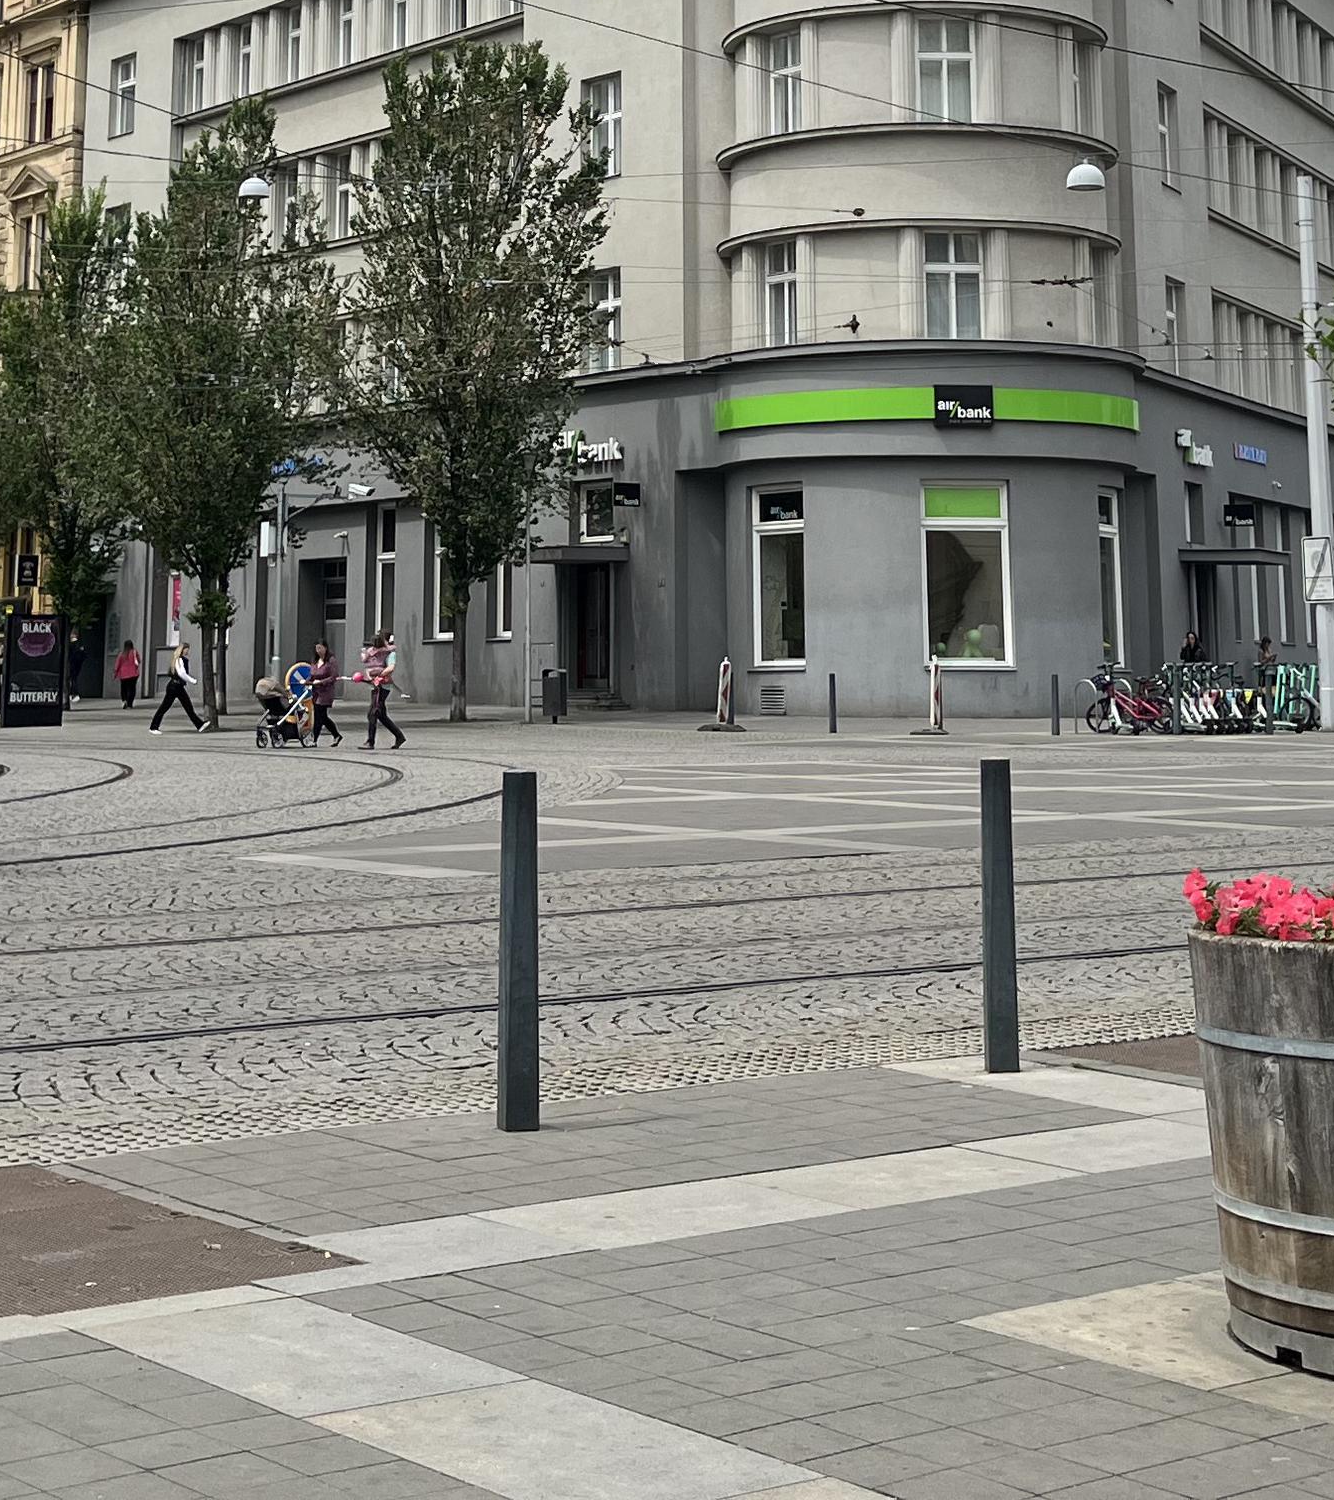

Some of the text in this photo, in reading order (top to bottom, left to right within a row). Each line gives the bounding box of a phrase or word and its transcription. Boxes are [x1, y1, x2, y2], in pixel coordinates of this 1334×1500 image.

[957, 406, 992, 419] bank
[22, 622, 53, 633] BLACK
[9, 691, 58, 703] BUTTERFLY
